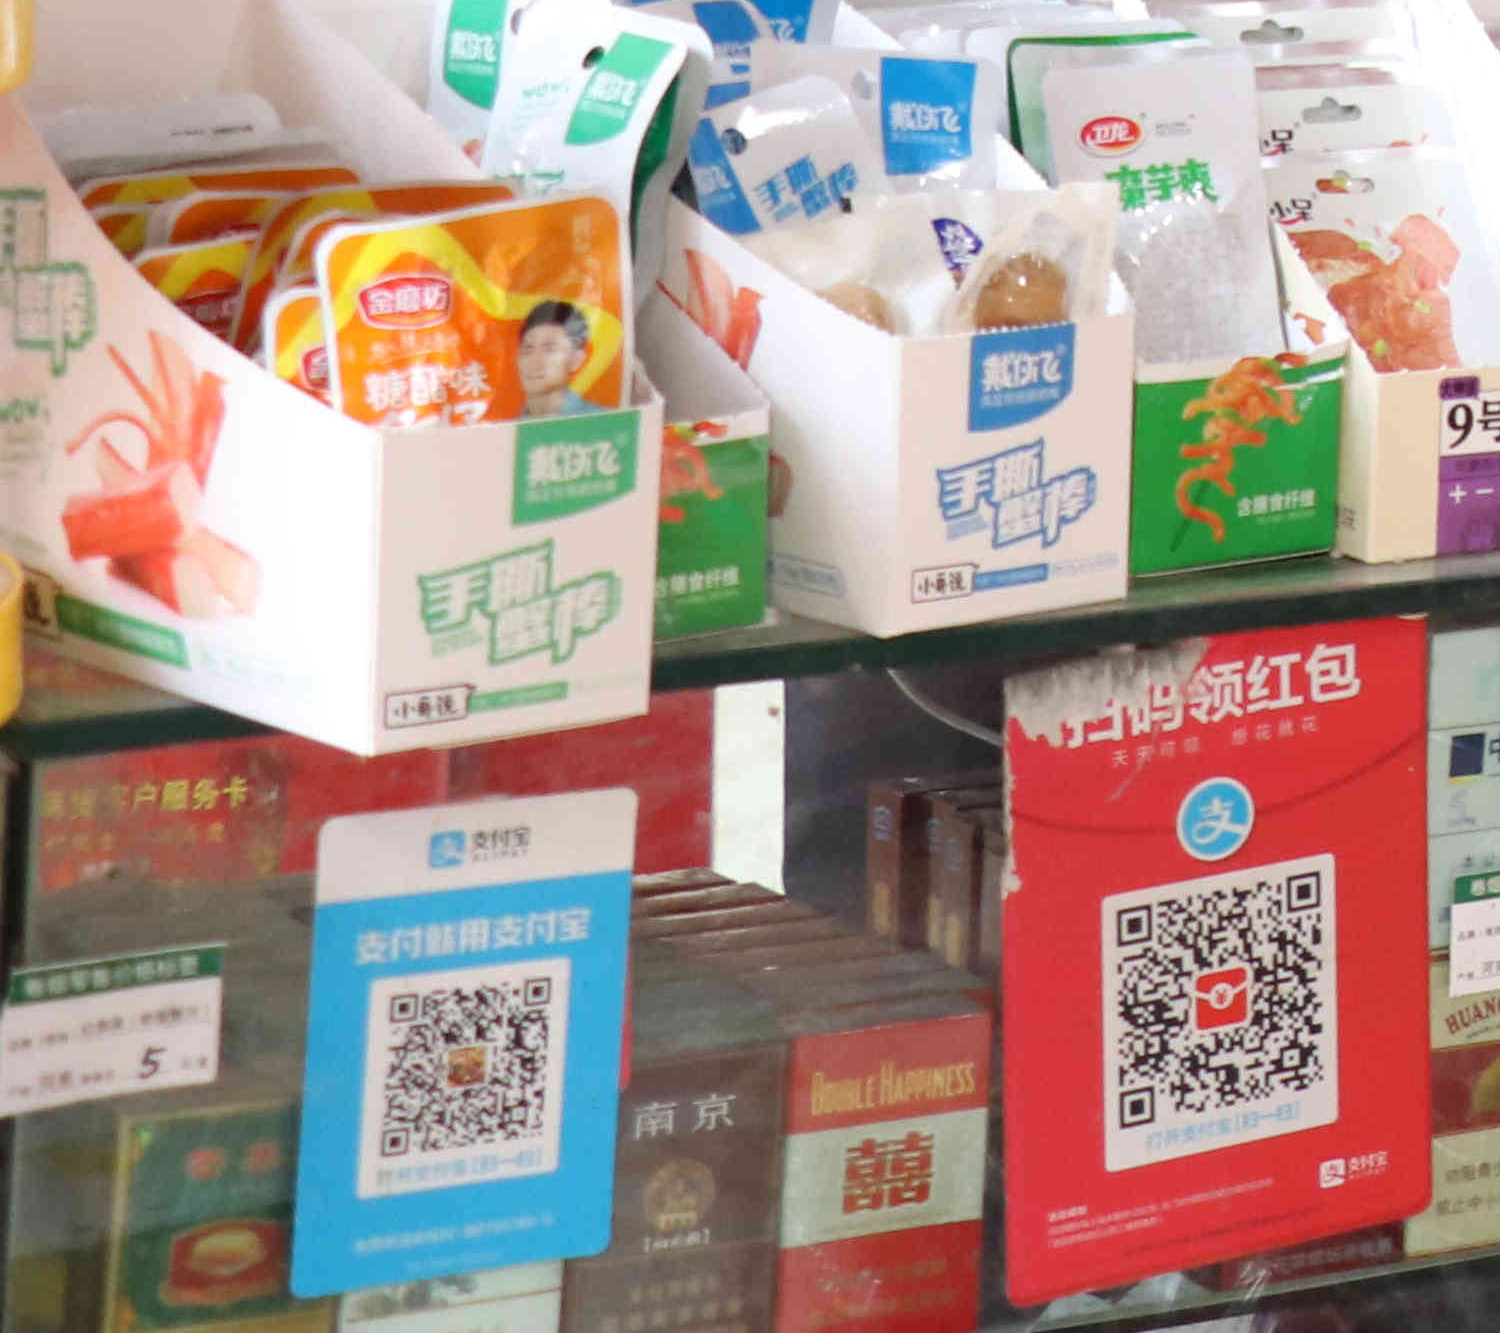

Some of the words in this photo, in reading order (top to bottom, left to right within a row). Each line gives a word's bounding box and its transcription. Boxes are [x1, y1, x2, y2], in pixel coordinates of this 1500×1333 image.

[359, 280, 453, 319] 金磨坊
[470, 826, 532, 850] 支付宝
[354, 908, 592, 965] 支付就用支付宝
[136, 1046, 168, 1081] 5
[810, 1069, 879, 1117] DOUBLE
[879, 1060, 976, 1106] HAPPINESS
[633, 1092, 736, 1142] 南京
